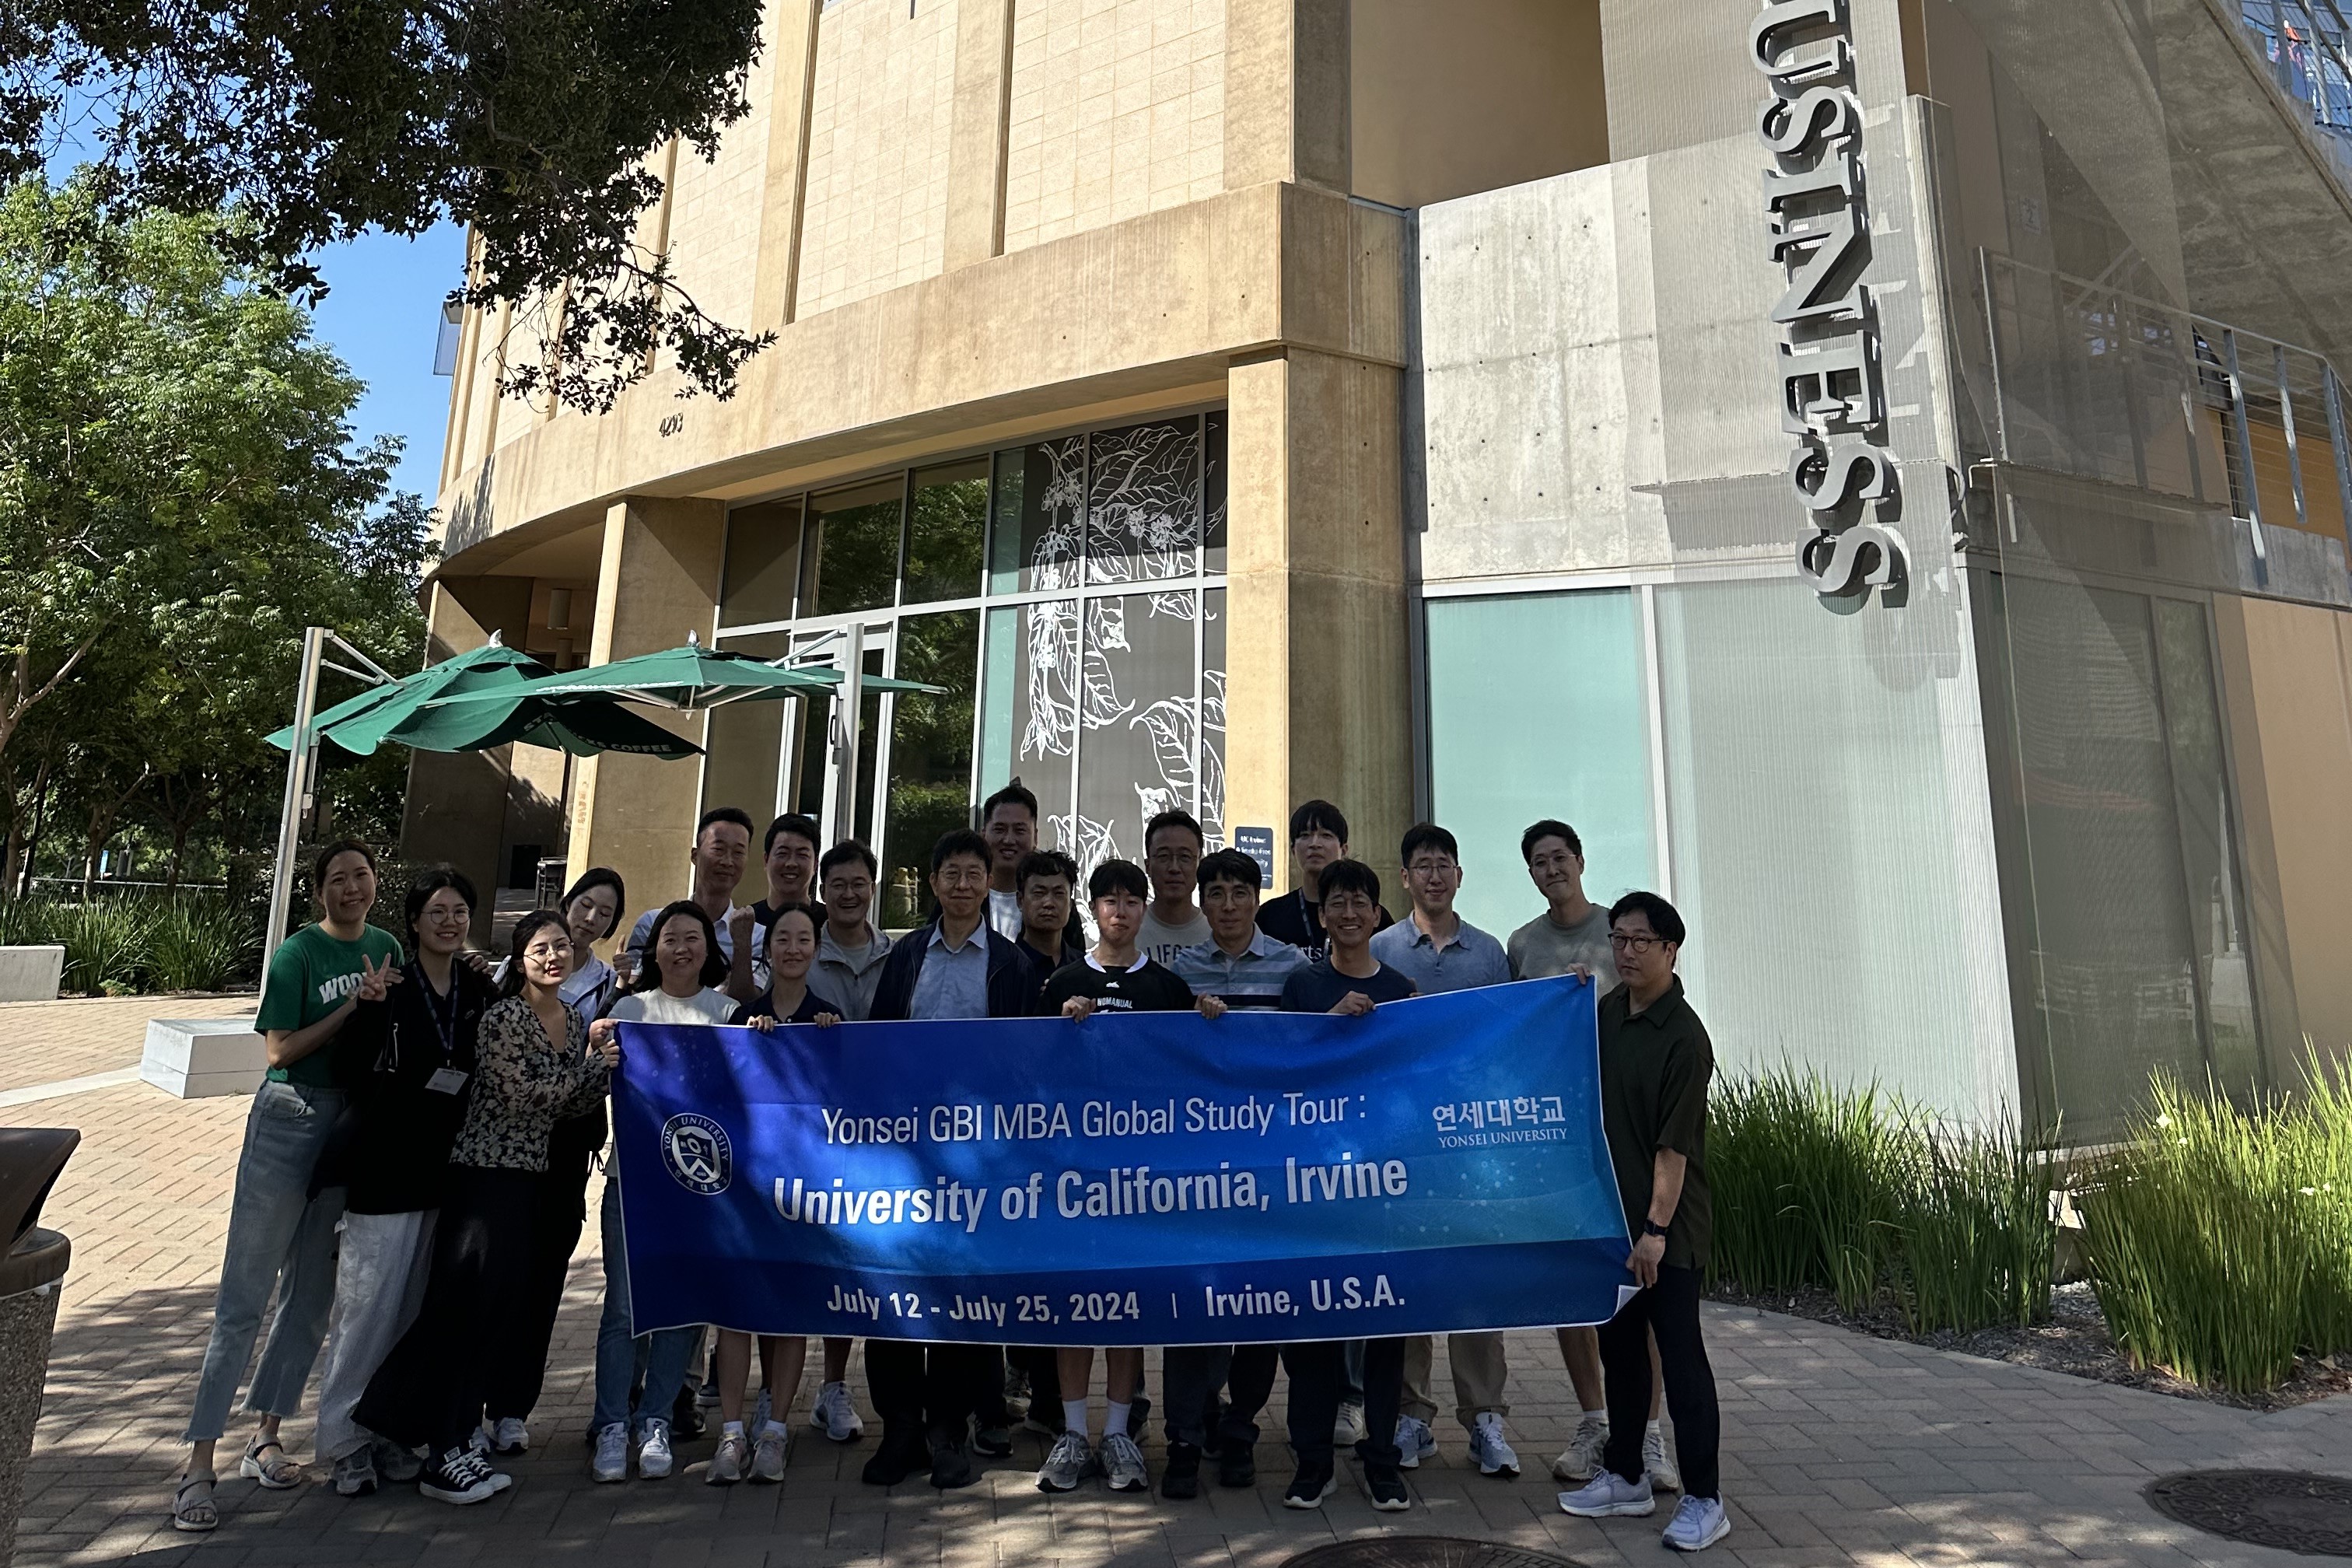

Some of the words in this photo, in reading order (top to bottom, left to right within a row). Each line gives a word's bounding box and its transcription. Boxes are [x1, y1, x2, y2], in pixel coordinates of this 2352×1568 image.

[1748, 0, 1896, 594] USINESS
[611, 744, 671, 752] COFFEE
[318, 972, 368, 1005] WOO
[822, 1107, 919, 1144] Yonsei
[930, 1104, 982, 1142] GBI
[994, 1101, 1072, 1139] MBA
[1082, 1097, 1174, 1136] Global
[1185, 1095, 1275, 1136] Study
[1283, 1092, 1349, 1126] Tour
[1432, 1096, 1566, 1132] 연세대학교
[681, 1116, 729, 1161] UNIVERSITY
[1438, 1132, 1488, 1149] YONSEI
[1490, 1128, 1567, 1145] UNIVERSITY
[775, 1176, 988, 1233] University
[1000, 1172, 1045, 1219] of
[1056, 1161, 1269, 1220] California,
[1286, 1152, 1408, 1204] Irvine
[827, 1285, 880, 1320] July
[889, 1292, 922, 1318] 12
[949, 1290, 1006, 1326] July
[1016, 1294, 1059, 1324] 25,
[1069, 1291, 1139, 1321] 2024
[1206, 1283, 1299, 1317] Irvine,
[1311, 1274, 1405, 1311] U.S.A.
